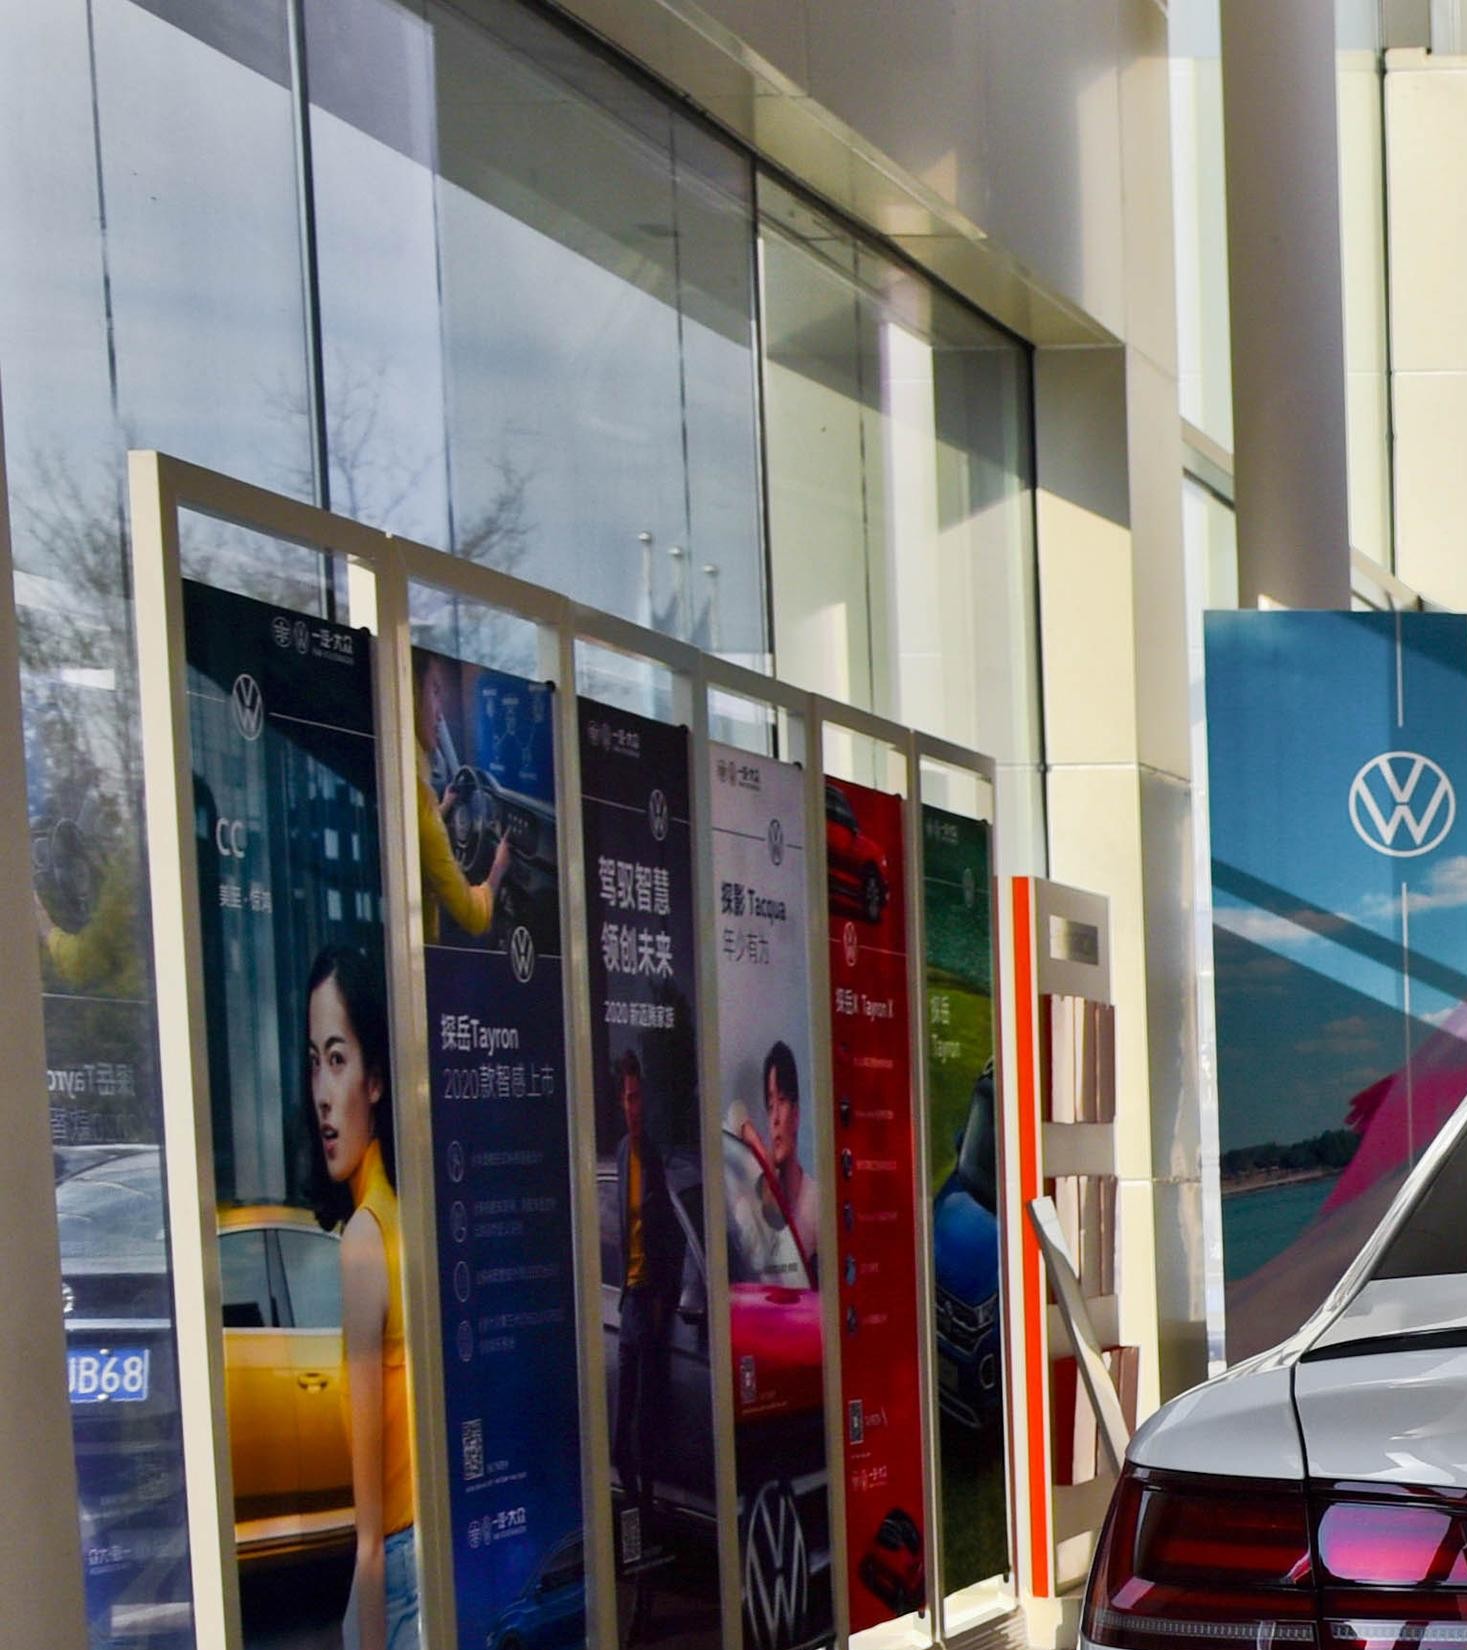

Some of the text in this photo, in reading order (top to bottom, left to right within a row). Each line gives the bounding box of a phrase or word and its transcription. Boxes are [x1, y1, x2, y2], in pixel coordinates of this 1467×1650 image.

[216, 817, 245, 858] CC
[598, 855, 671, 915] 驾驭智慧
[601, 921, 674, 978] 领创未来
